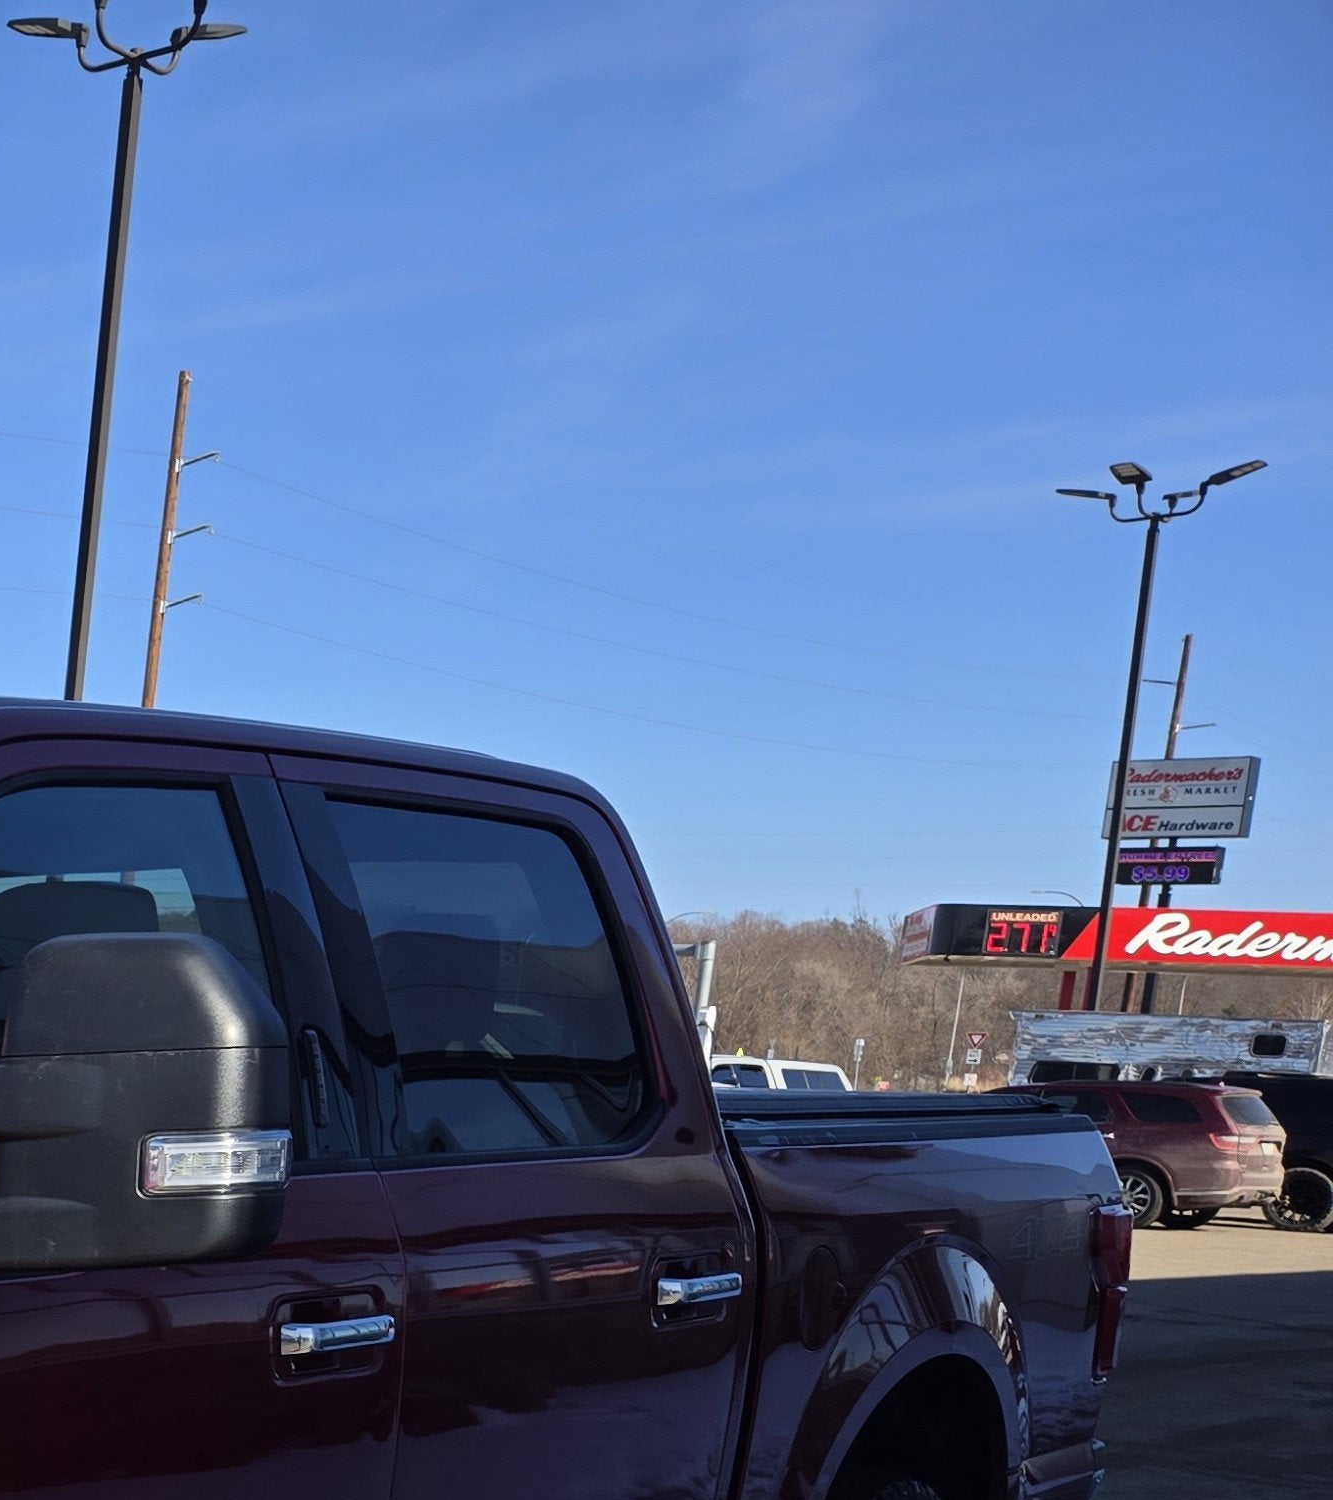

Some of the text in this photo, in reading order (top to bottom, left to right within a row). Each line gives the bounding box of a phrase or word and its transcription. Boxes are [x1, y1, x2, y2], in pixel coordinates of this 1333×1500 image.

[1184, 786, 1238, 795] MARKET
[1157, 820, 1234, 831] Hardware
[1131, 865, 1190, 881] $5.99
[992, 911, 1059, 922] UNLEADED
